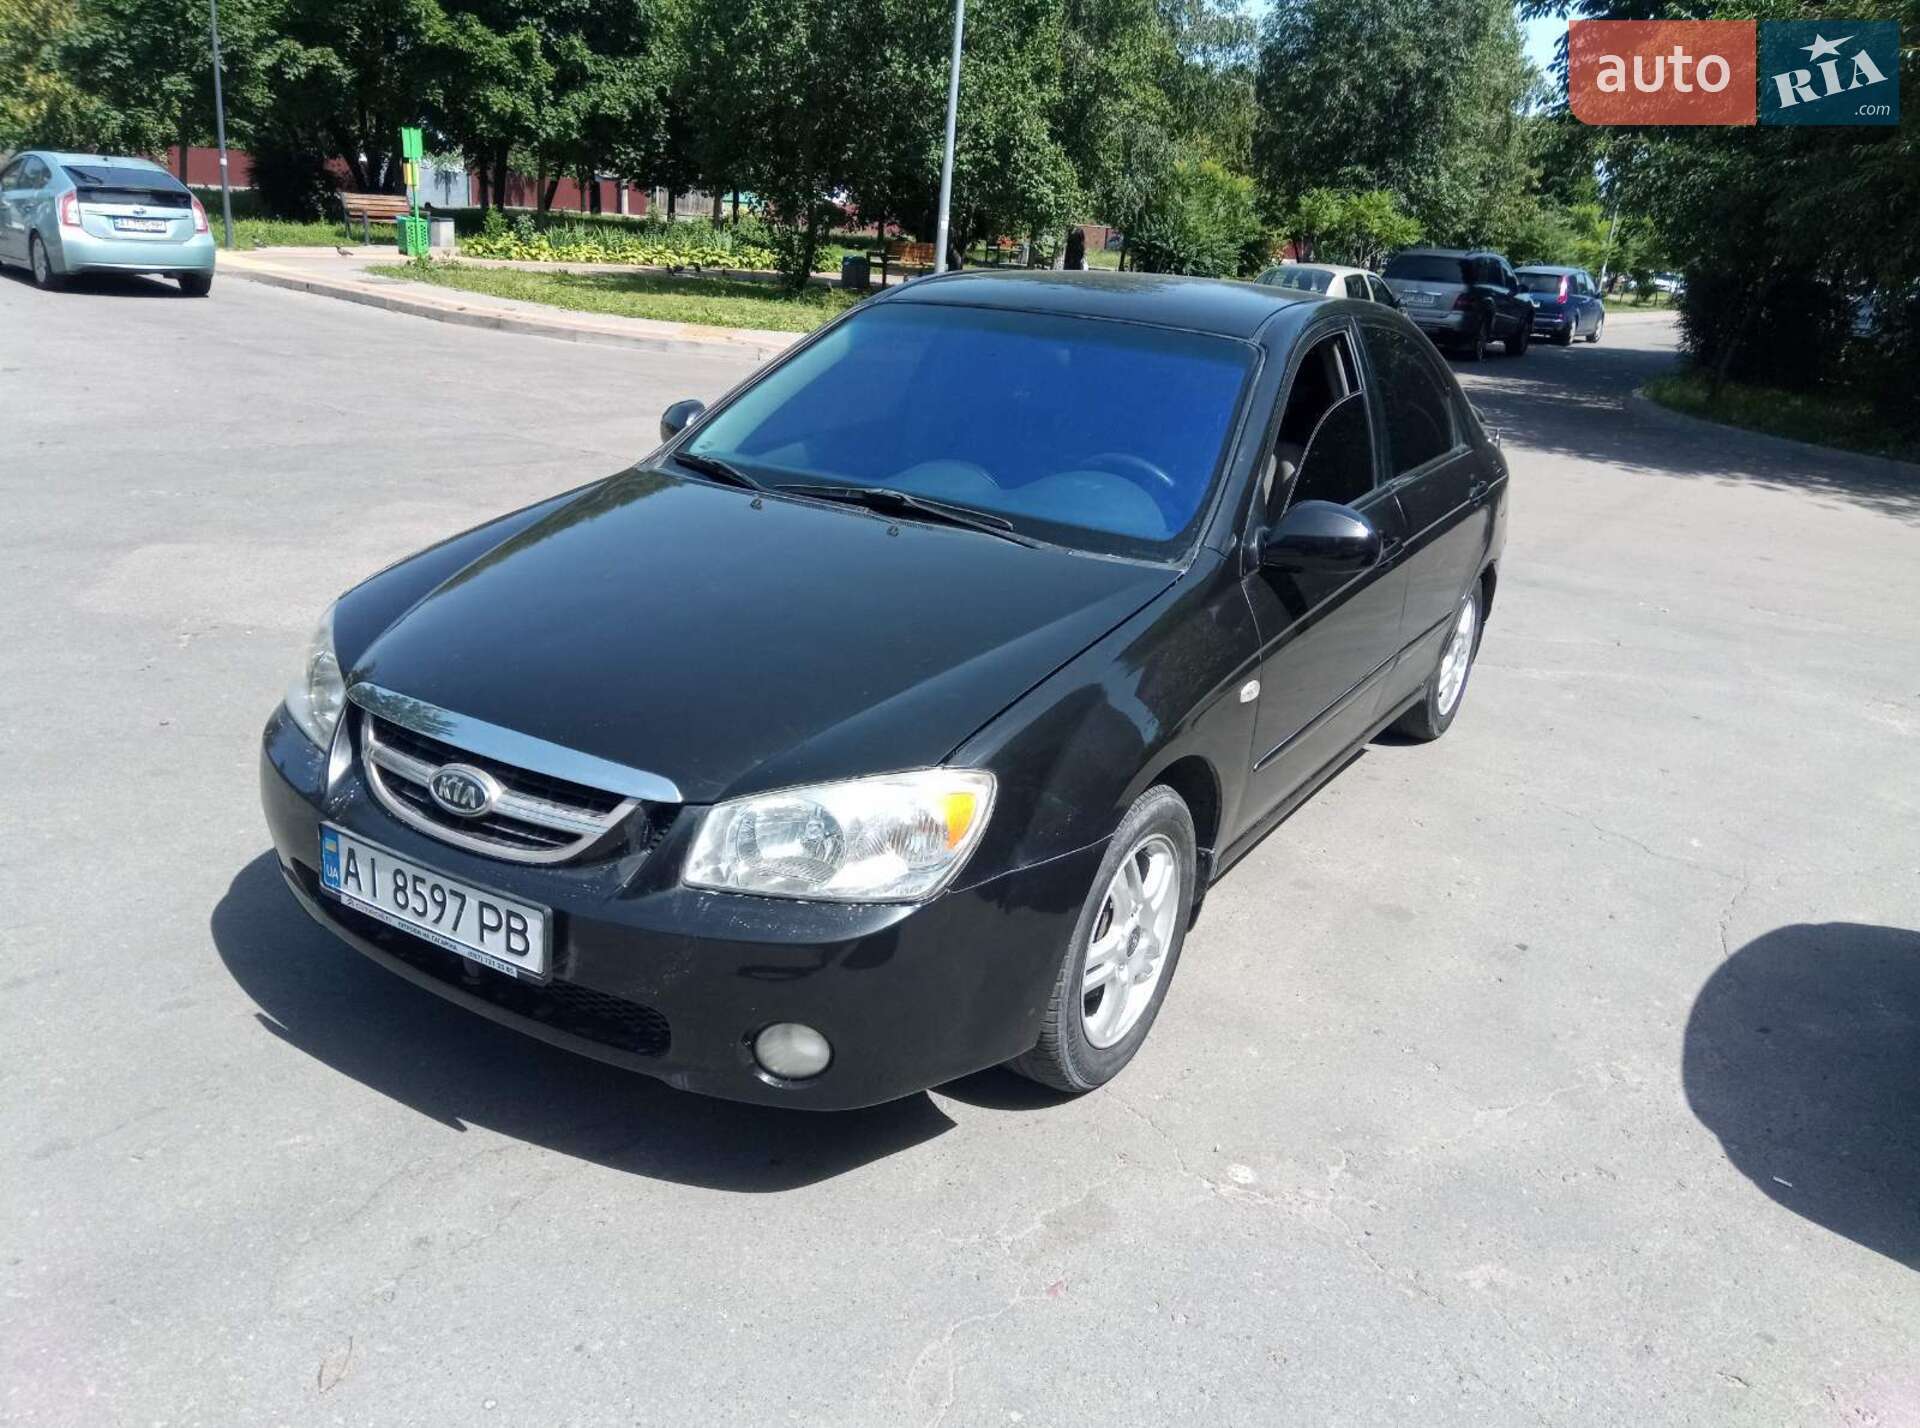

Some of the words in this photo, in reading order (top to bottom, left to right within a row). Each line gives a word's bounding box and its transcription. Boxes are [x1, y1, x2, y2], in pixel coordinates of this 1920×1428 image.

[438, 775, 476, 808] KIA
[326, 864, 339, 881] UA
[344, 847, 377, 898] AI
[393, 868, 467, 932] 8597
[478, 900, 530, 957] PB
